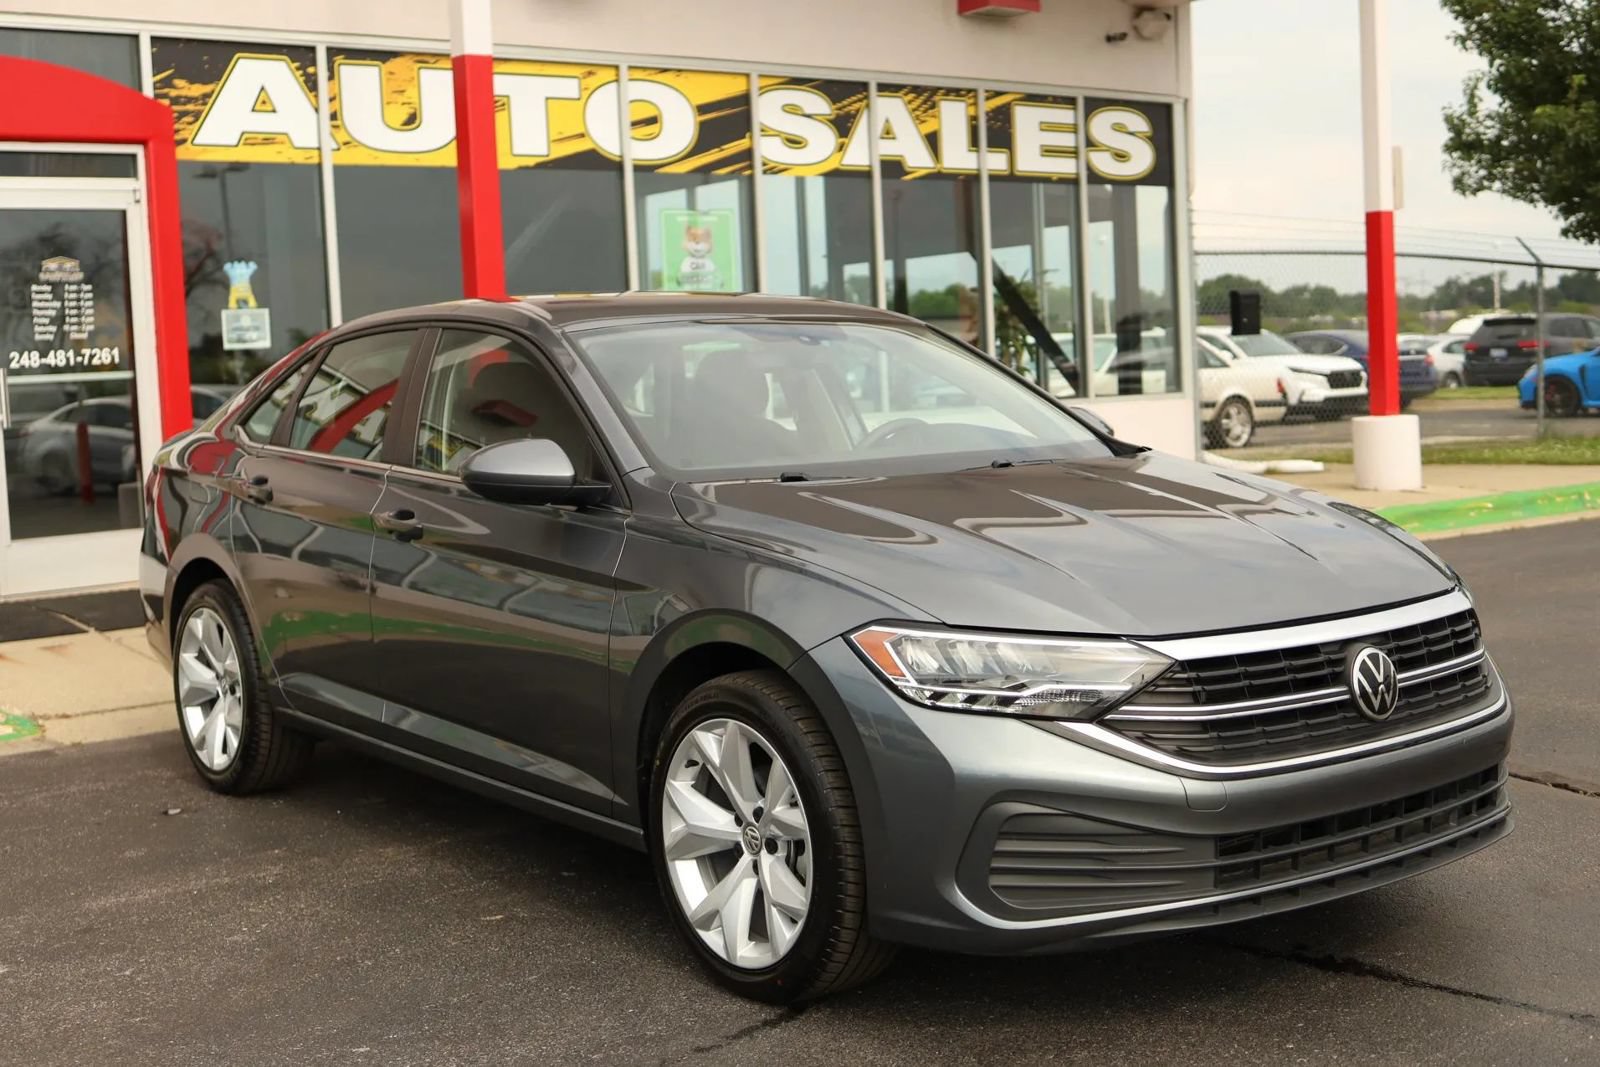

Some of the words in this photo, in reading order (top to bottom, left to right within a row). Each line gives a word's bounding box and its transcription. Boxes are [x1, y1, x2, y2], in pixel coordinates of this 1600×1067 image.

[189, 53, 698, 165] AUTO
[757, 84, 1157, 181] SALES
[9, 346, 120, 369] 248-481-7261
